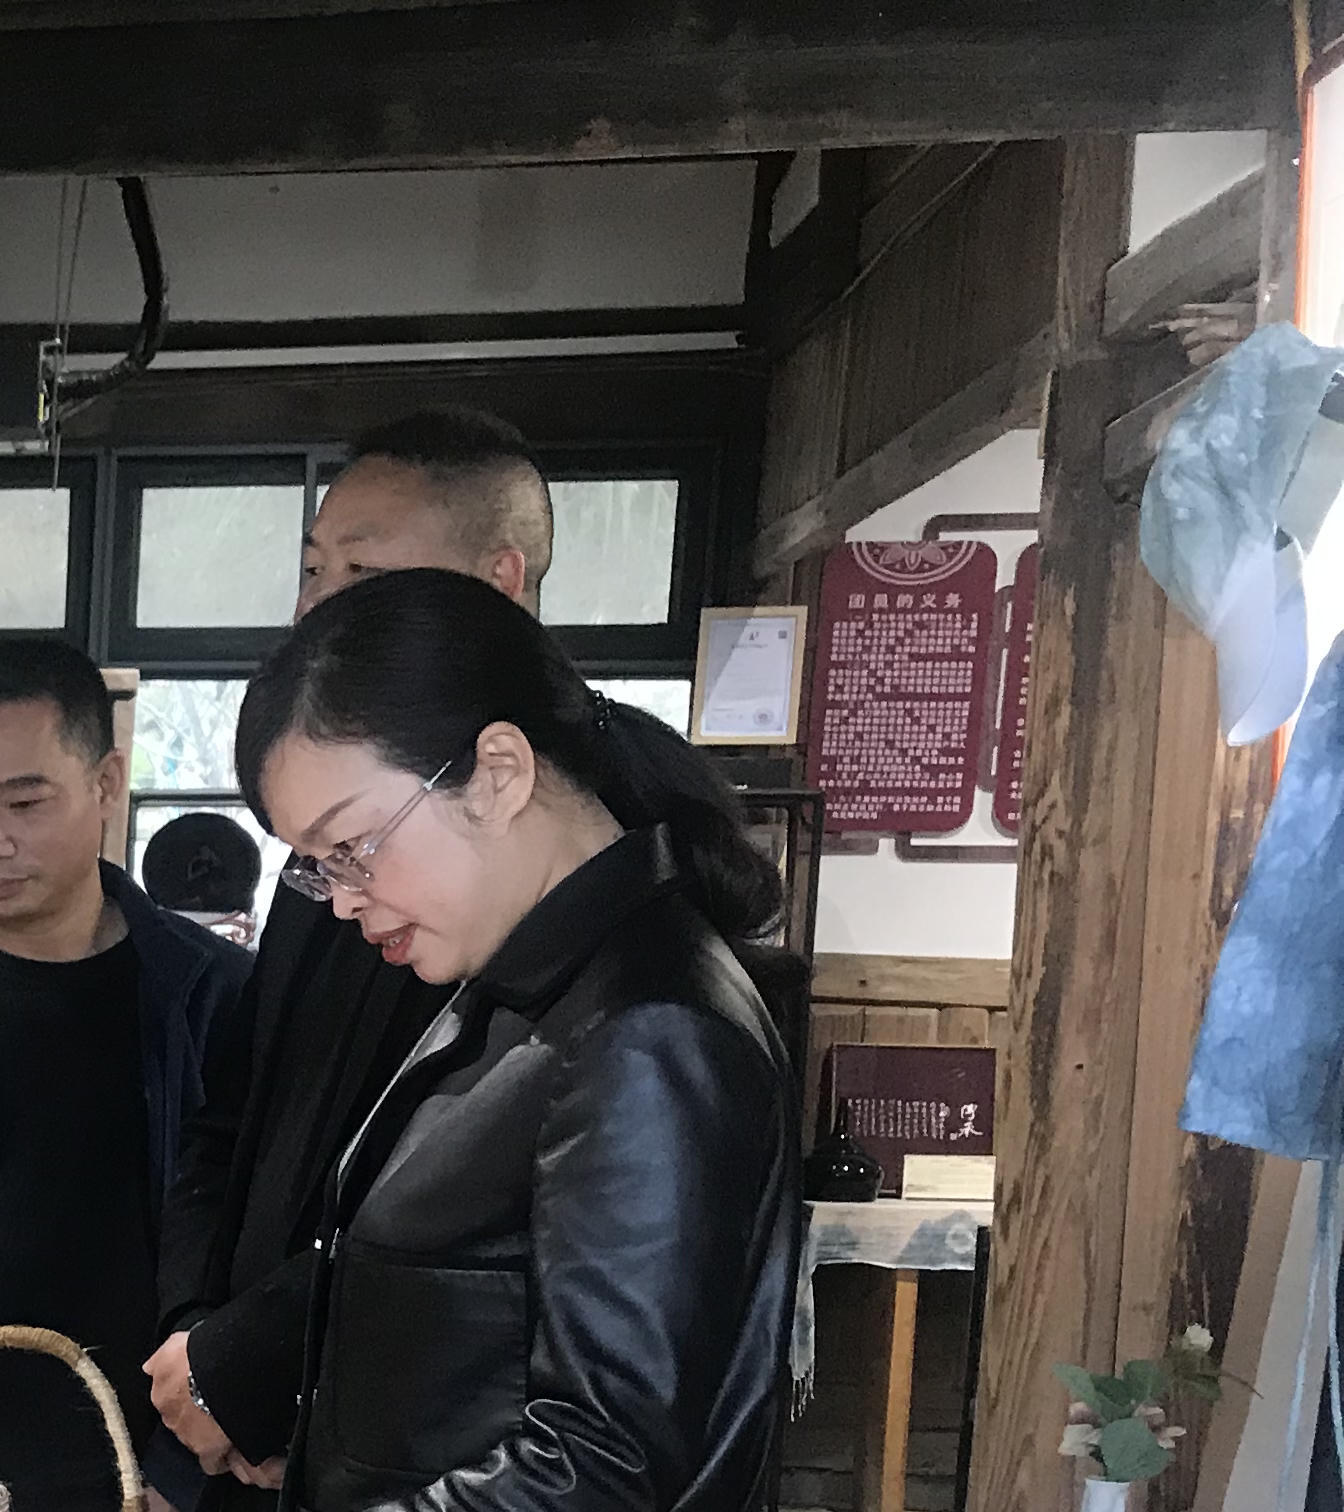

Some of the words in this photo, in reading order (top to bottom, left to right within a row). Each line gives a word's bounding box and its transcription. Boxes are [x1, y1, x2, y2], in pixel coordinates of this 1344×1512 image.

[848, 593, 962, 609] 团员的义务
